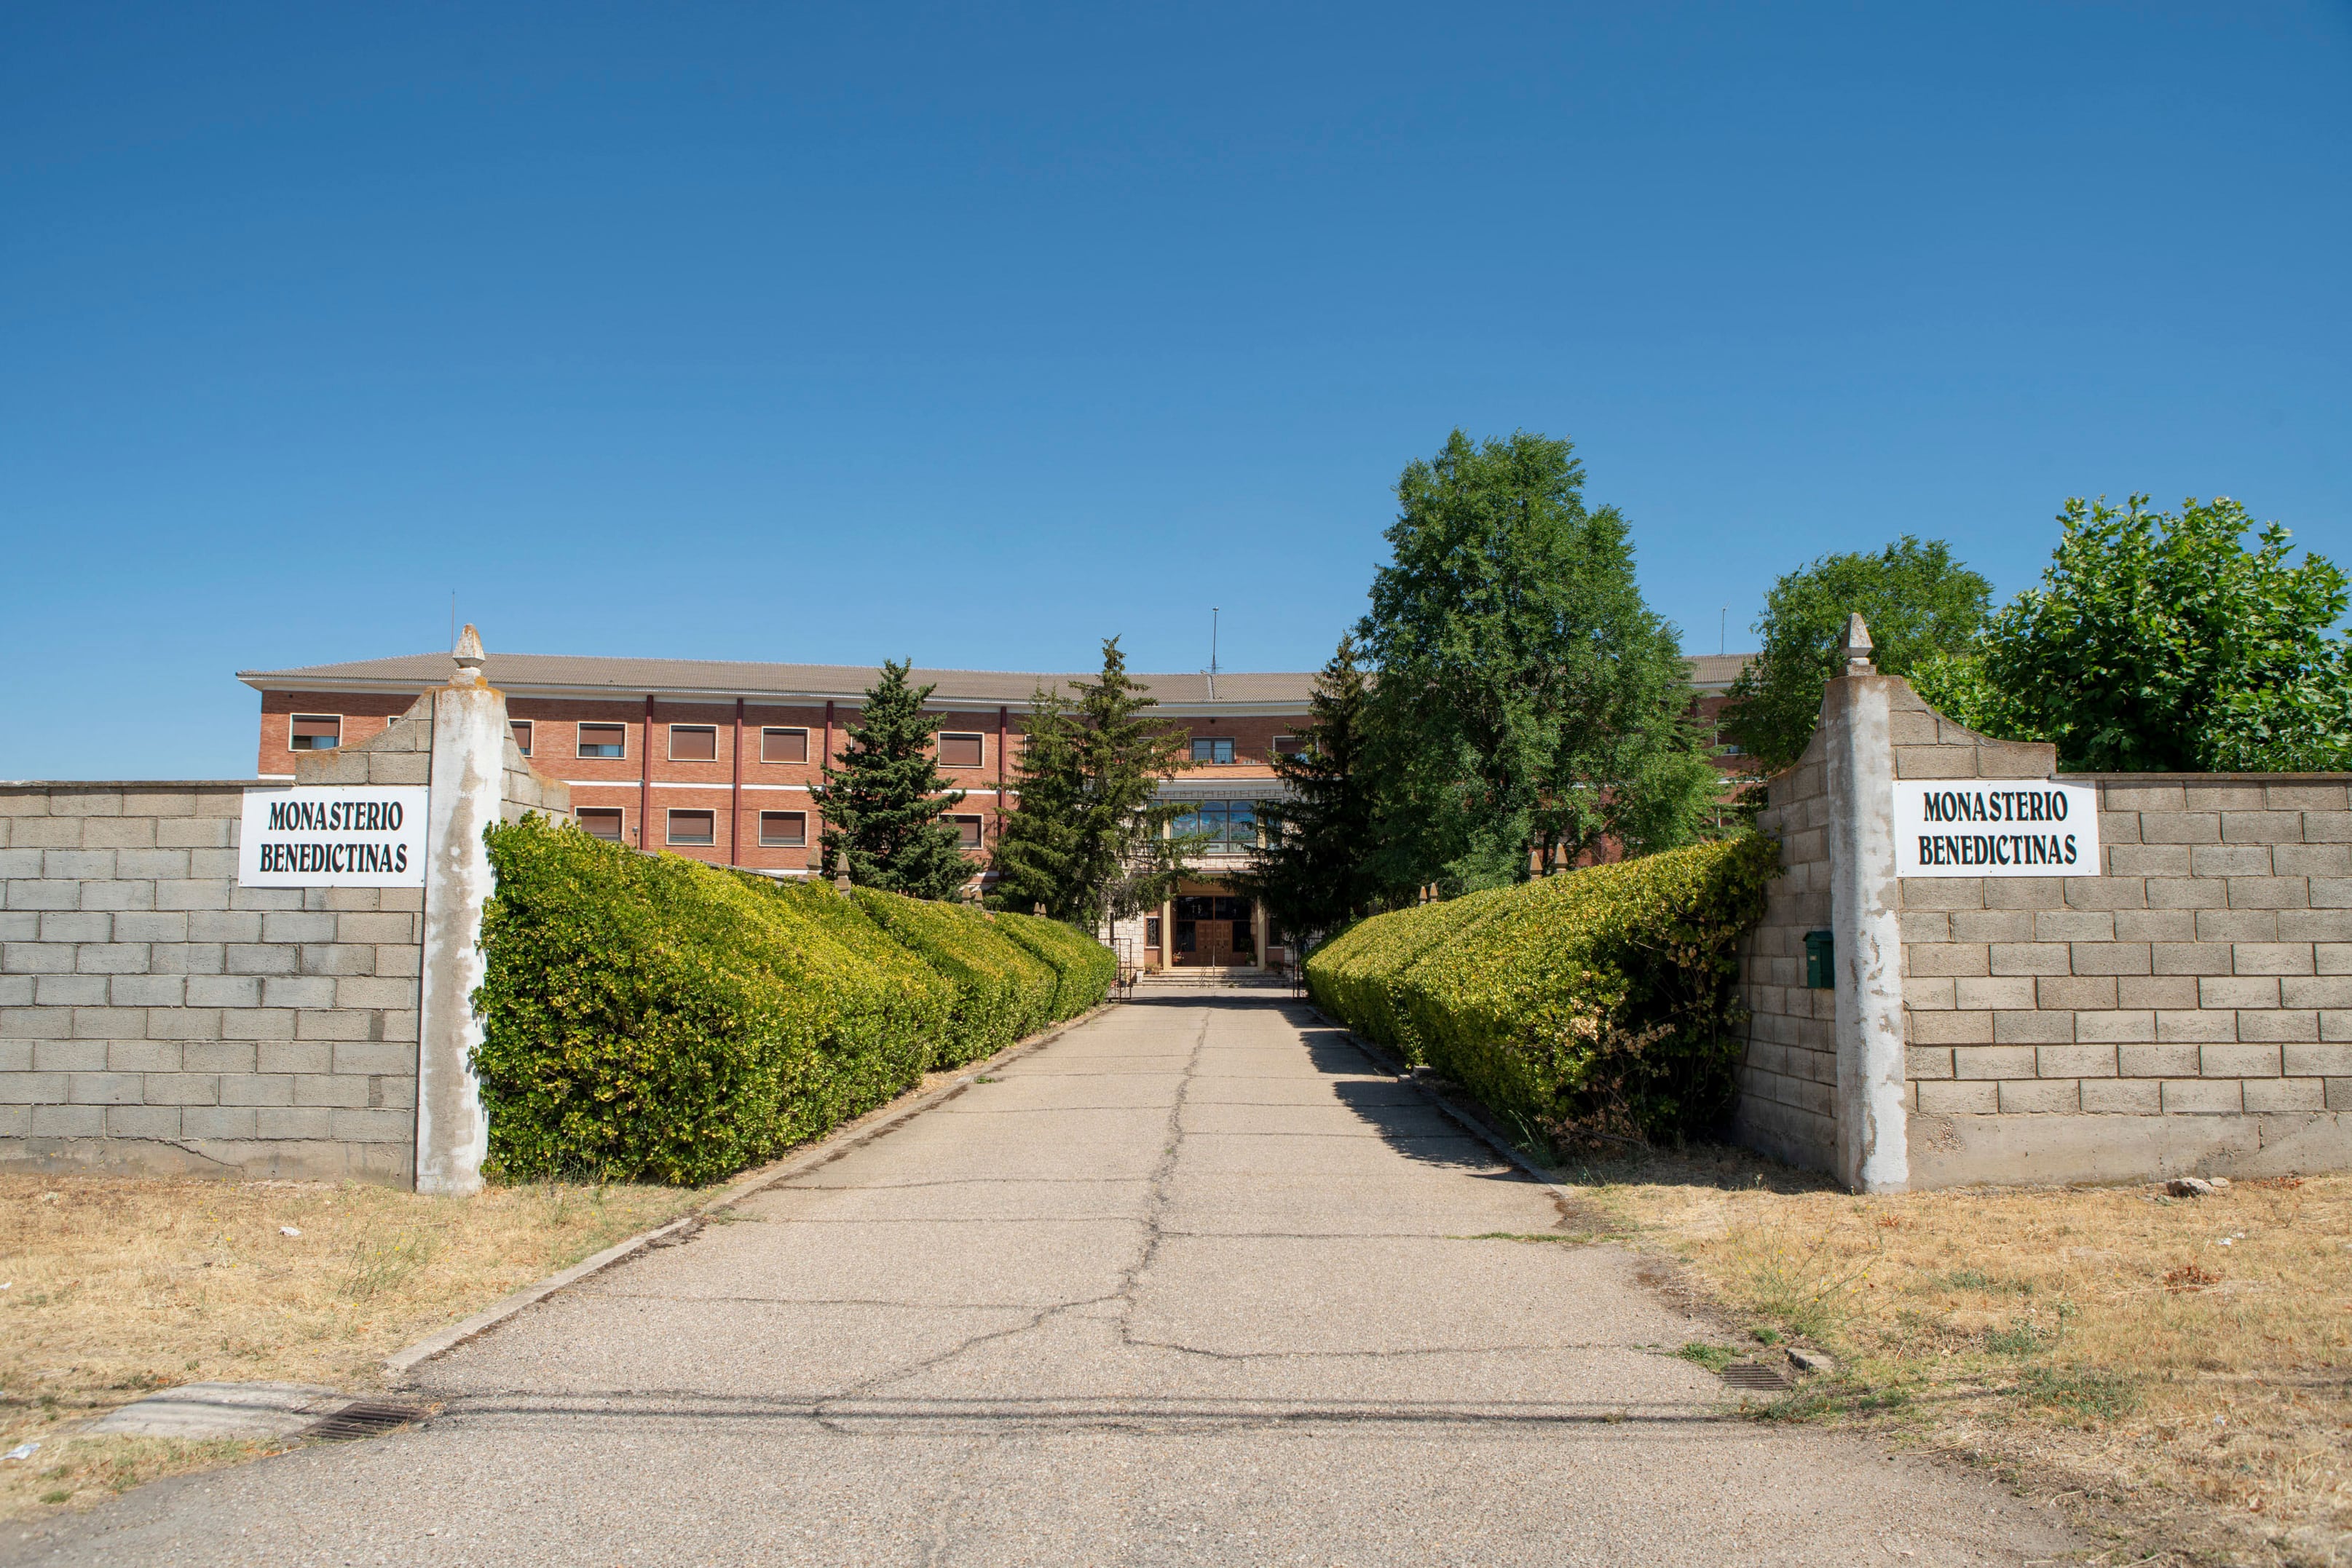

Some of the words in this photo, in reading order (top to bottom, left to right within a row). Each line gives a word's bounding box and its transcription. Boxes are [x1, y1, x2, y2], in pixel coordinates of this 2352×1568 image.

[268, 801, 403, 831] MONASTERIO
[1923, 791, 2068, 822] MONASTERIO
[260, 844, 408, 873] BENEDICTINAS
[1918, 834, 2076, 866] BENEDICTINAS
